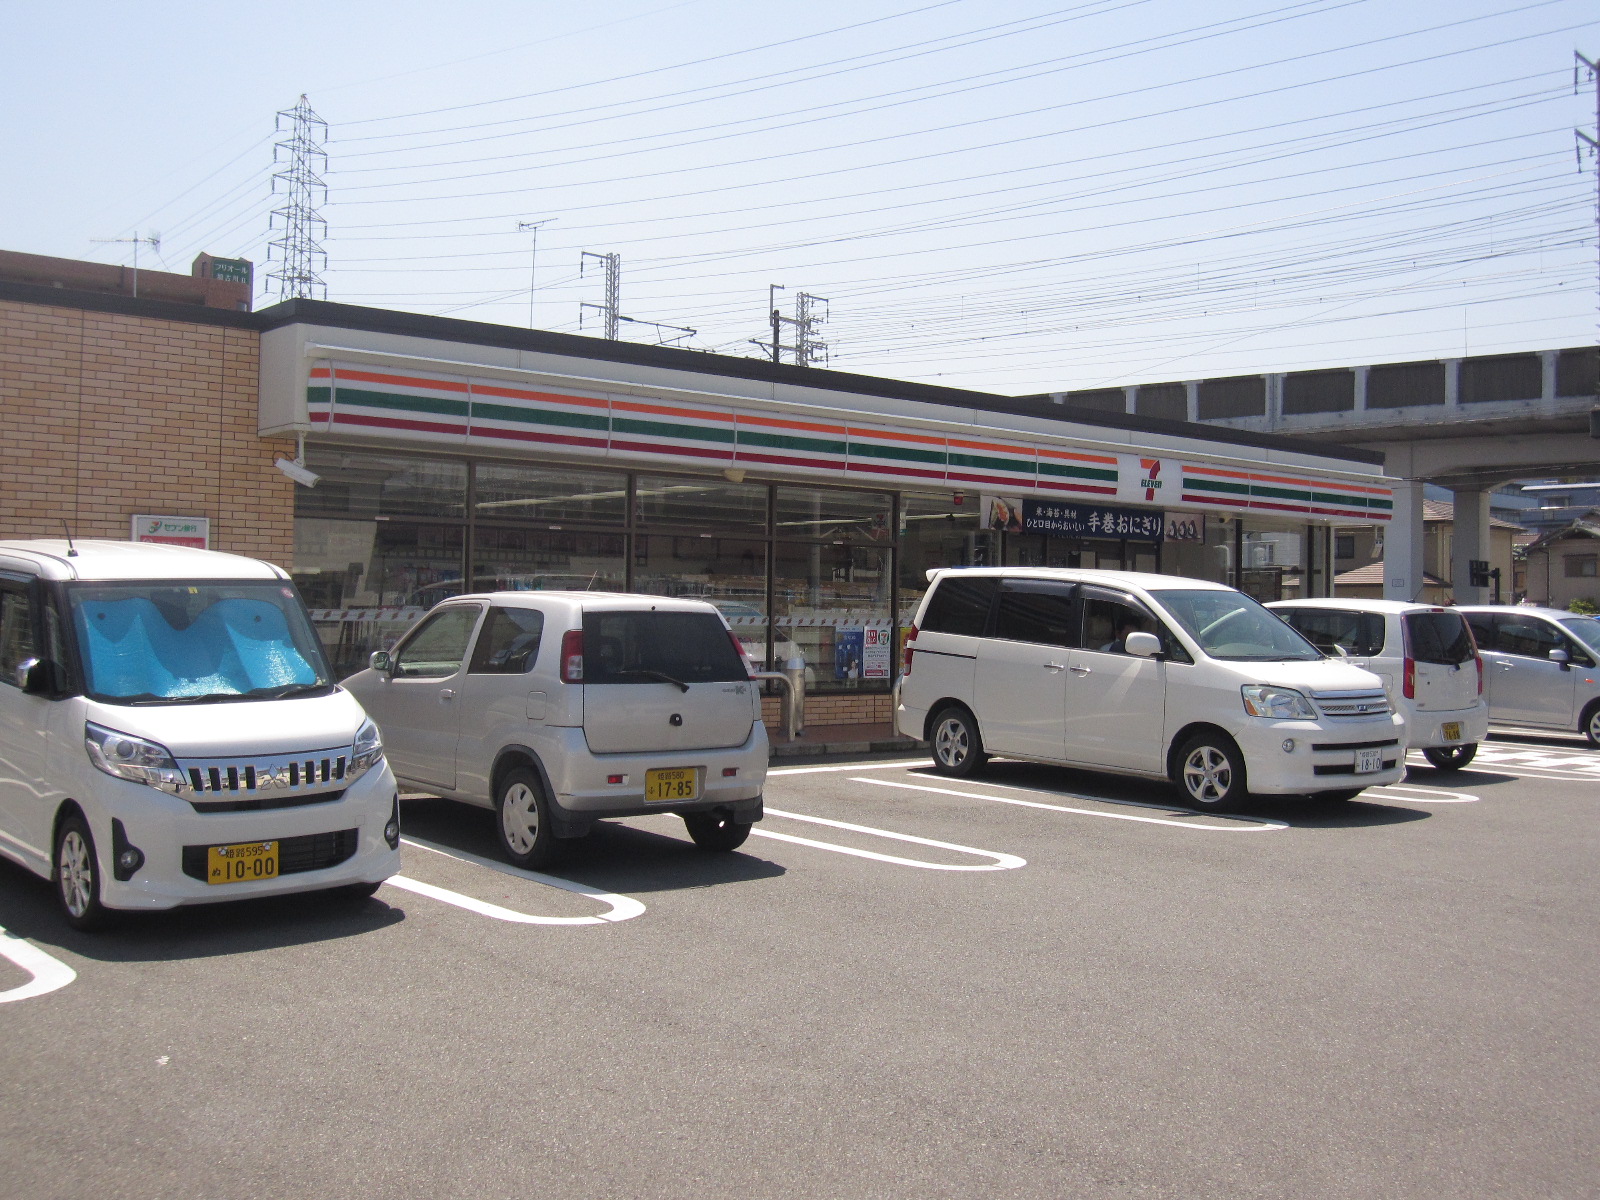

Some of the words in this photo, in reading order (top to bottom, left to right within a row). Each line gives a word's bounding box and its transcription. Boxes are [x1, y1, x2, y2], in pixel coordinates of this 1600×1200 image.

[1026, 517, 1085, 532] ひと口目からおいしい
[1087, 511, 1161, 536] 手巻おにぎり
[658, 780, 692, 797] 17-85
[226, 857, 275, 879] 10-00
